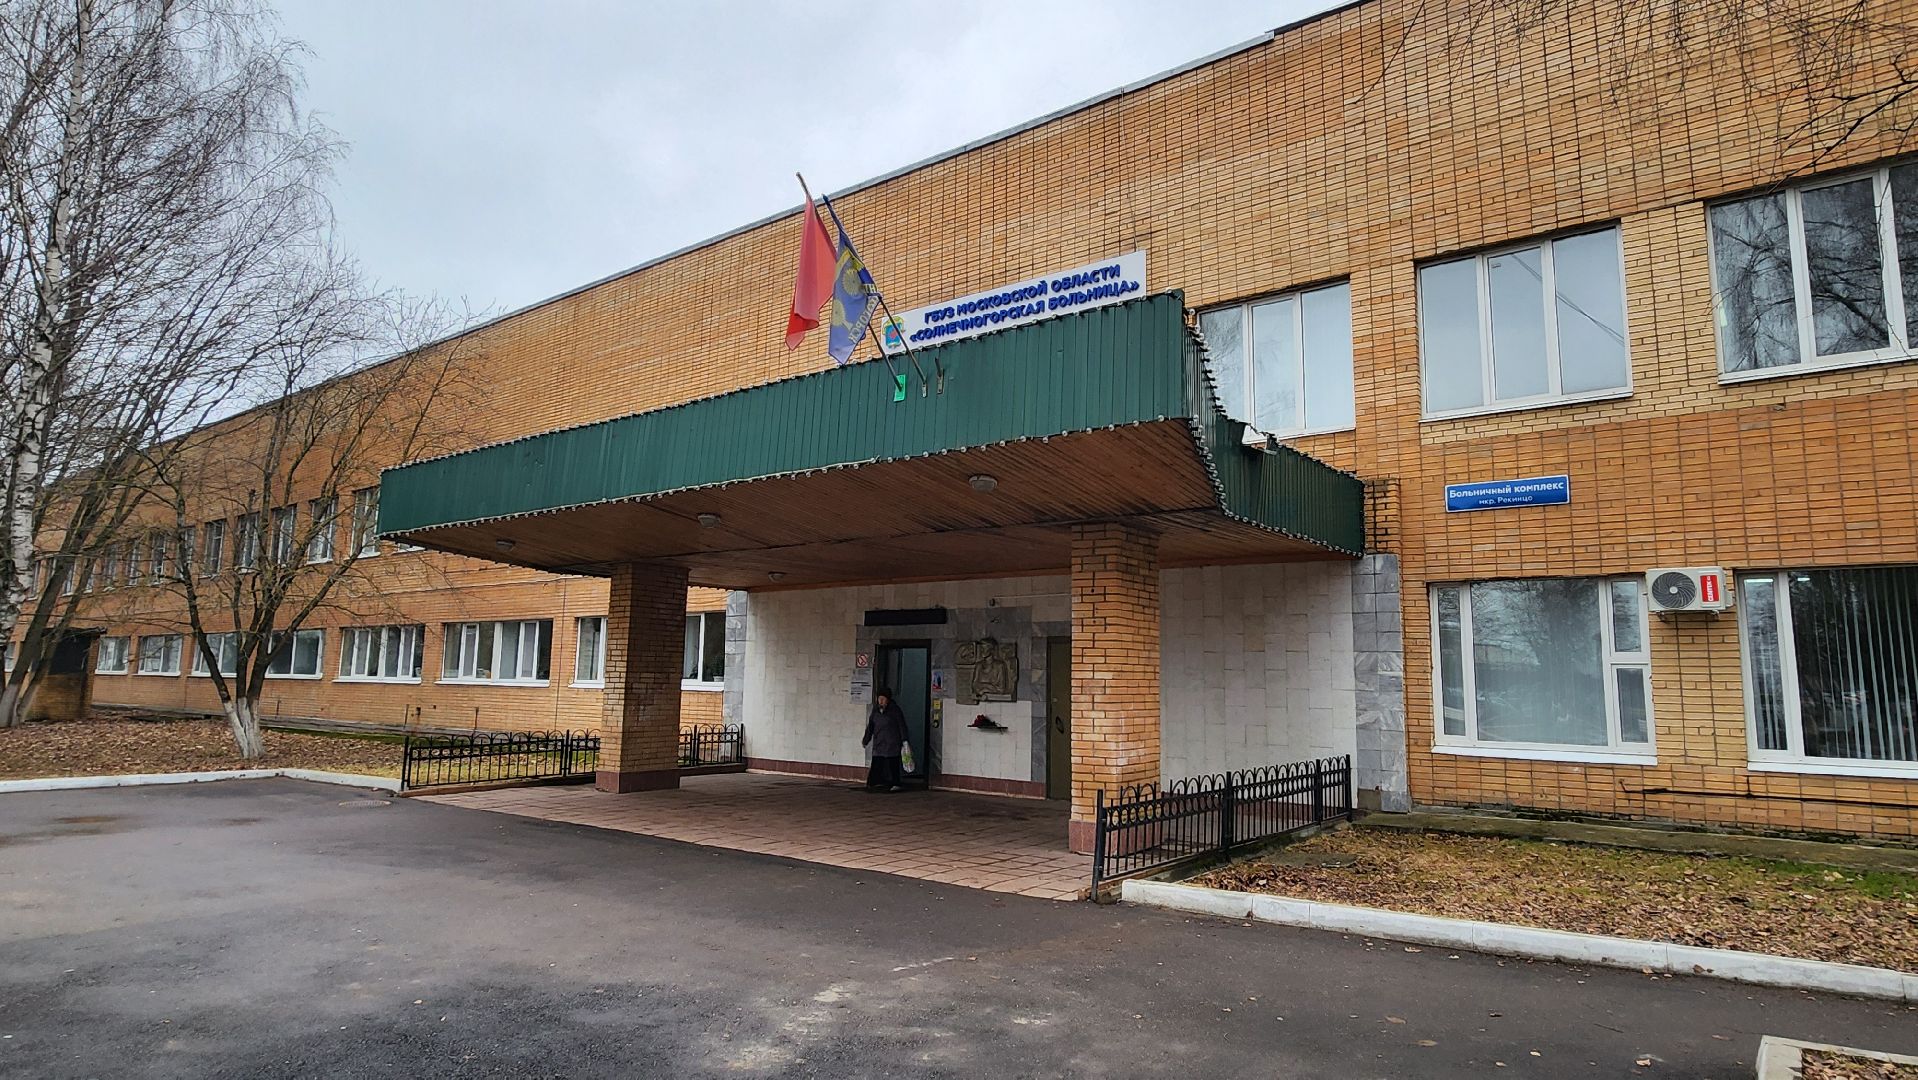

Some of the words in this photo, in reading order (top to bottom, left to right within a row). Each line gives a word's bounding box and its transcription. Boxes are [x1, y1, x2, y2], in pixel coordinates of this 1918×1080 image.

[910, 299, 1045, 342] «СОЛНЕЧНОГОРСКАЯ
[1048, 280, 1140, 310] БОЛЬНИЦА»
[924, 307, 955, 324] ГБУЗ
[957, 280, 1048, 316] МОСКОВСКОЙ
[1051, 264, 1120, 292] ОБЛАСТИ
[1449, 485, 1512, 498] Больничный
[1514, 482, 1564, 493] комплекс
[1479, 498, 1496, 506] мкр.
[1497, 495, 1533, 504] Рекинцо
